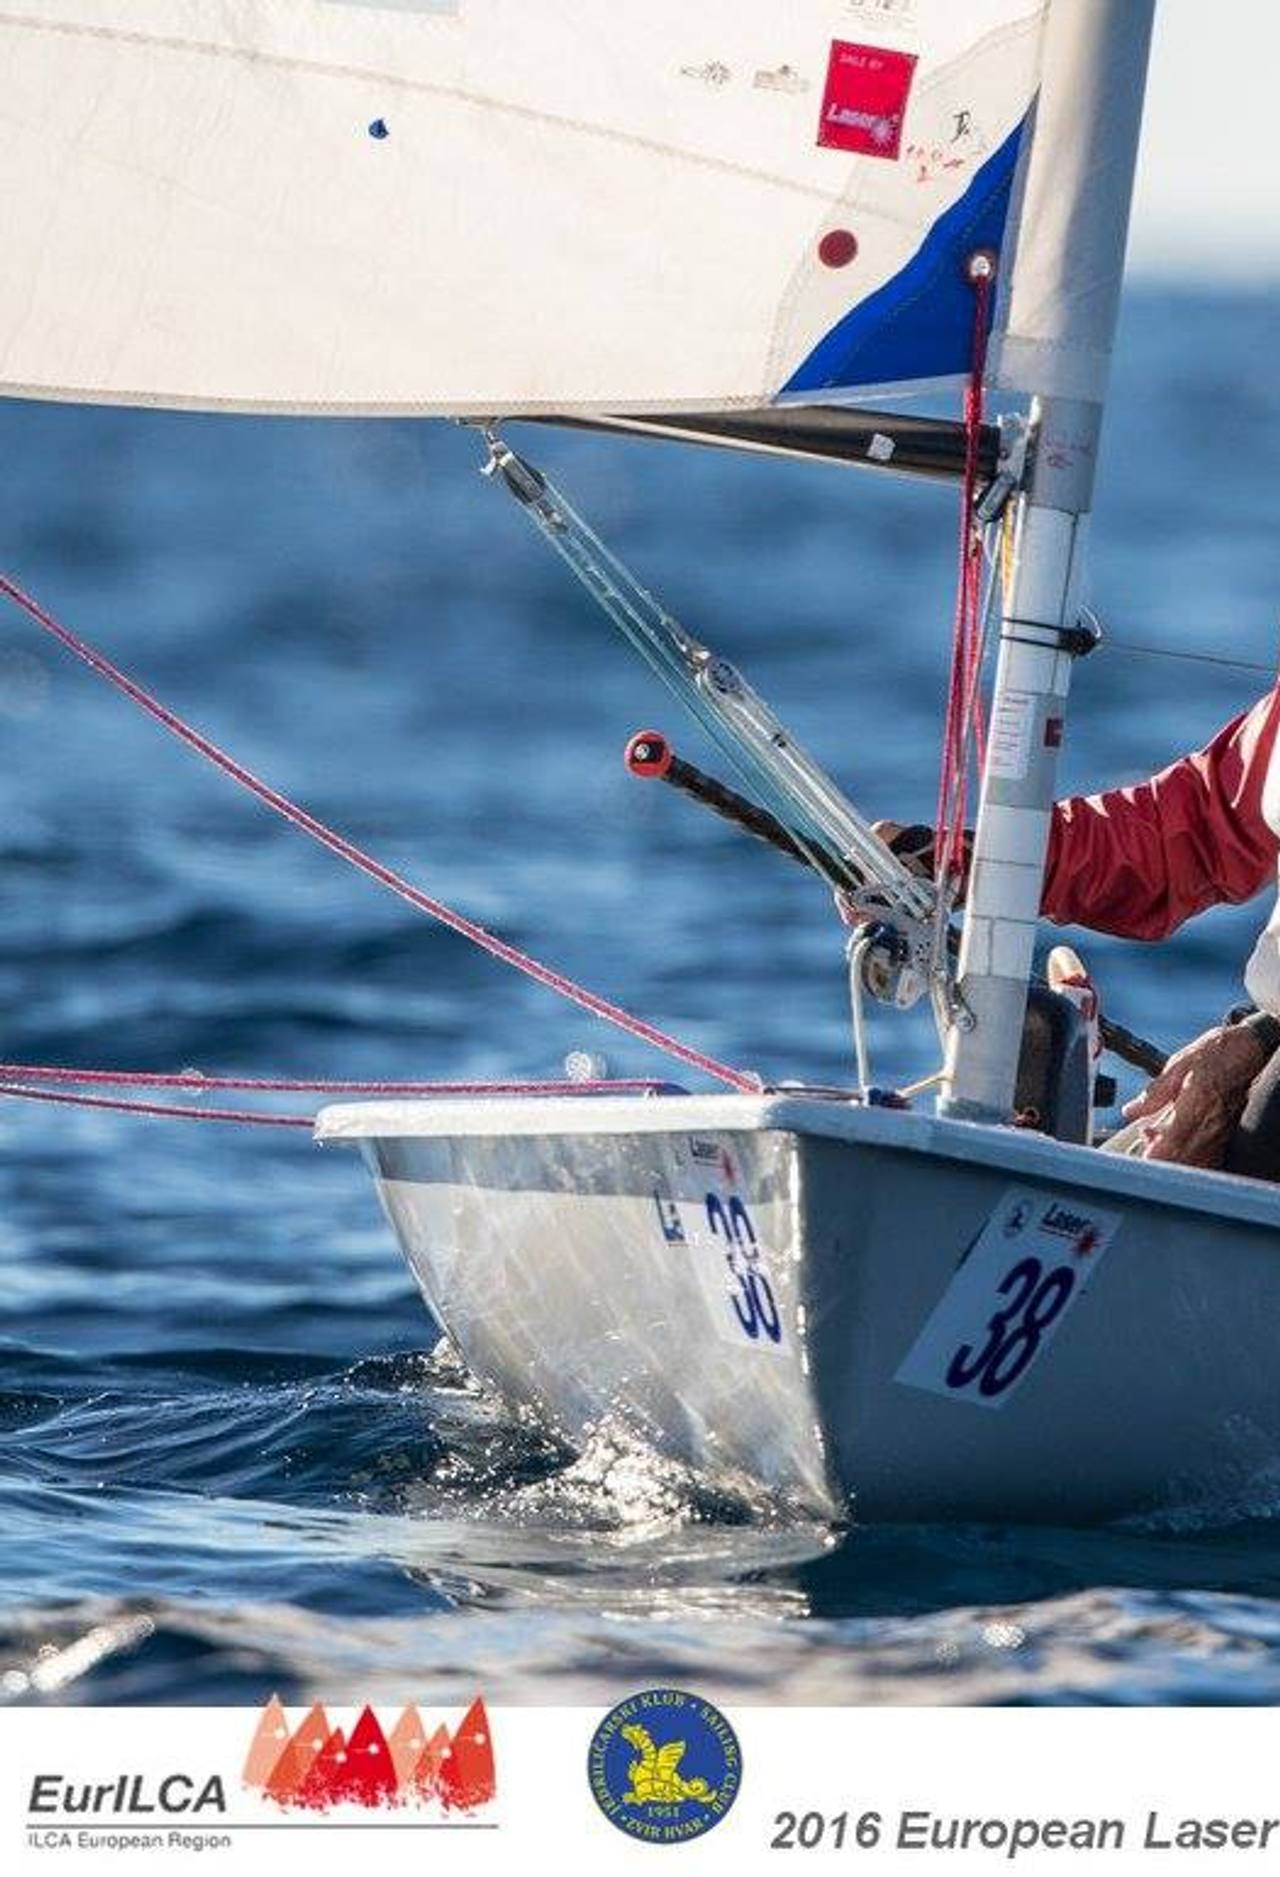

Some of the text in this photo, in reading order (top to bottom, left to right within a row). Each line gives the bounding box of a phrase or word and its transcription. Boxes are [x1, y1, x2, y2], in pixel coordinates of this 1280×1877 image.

[826, 102, 876, 130] Laser
[1042, 1203, 1093, 1231] Laser
[946, 1257, 1075, 1396] 38
